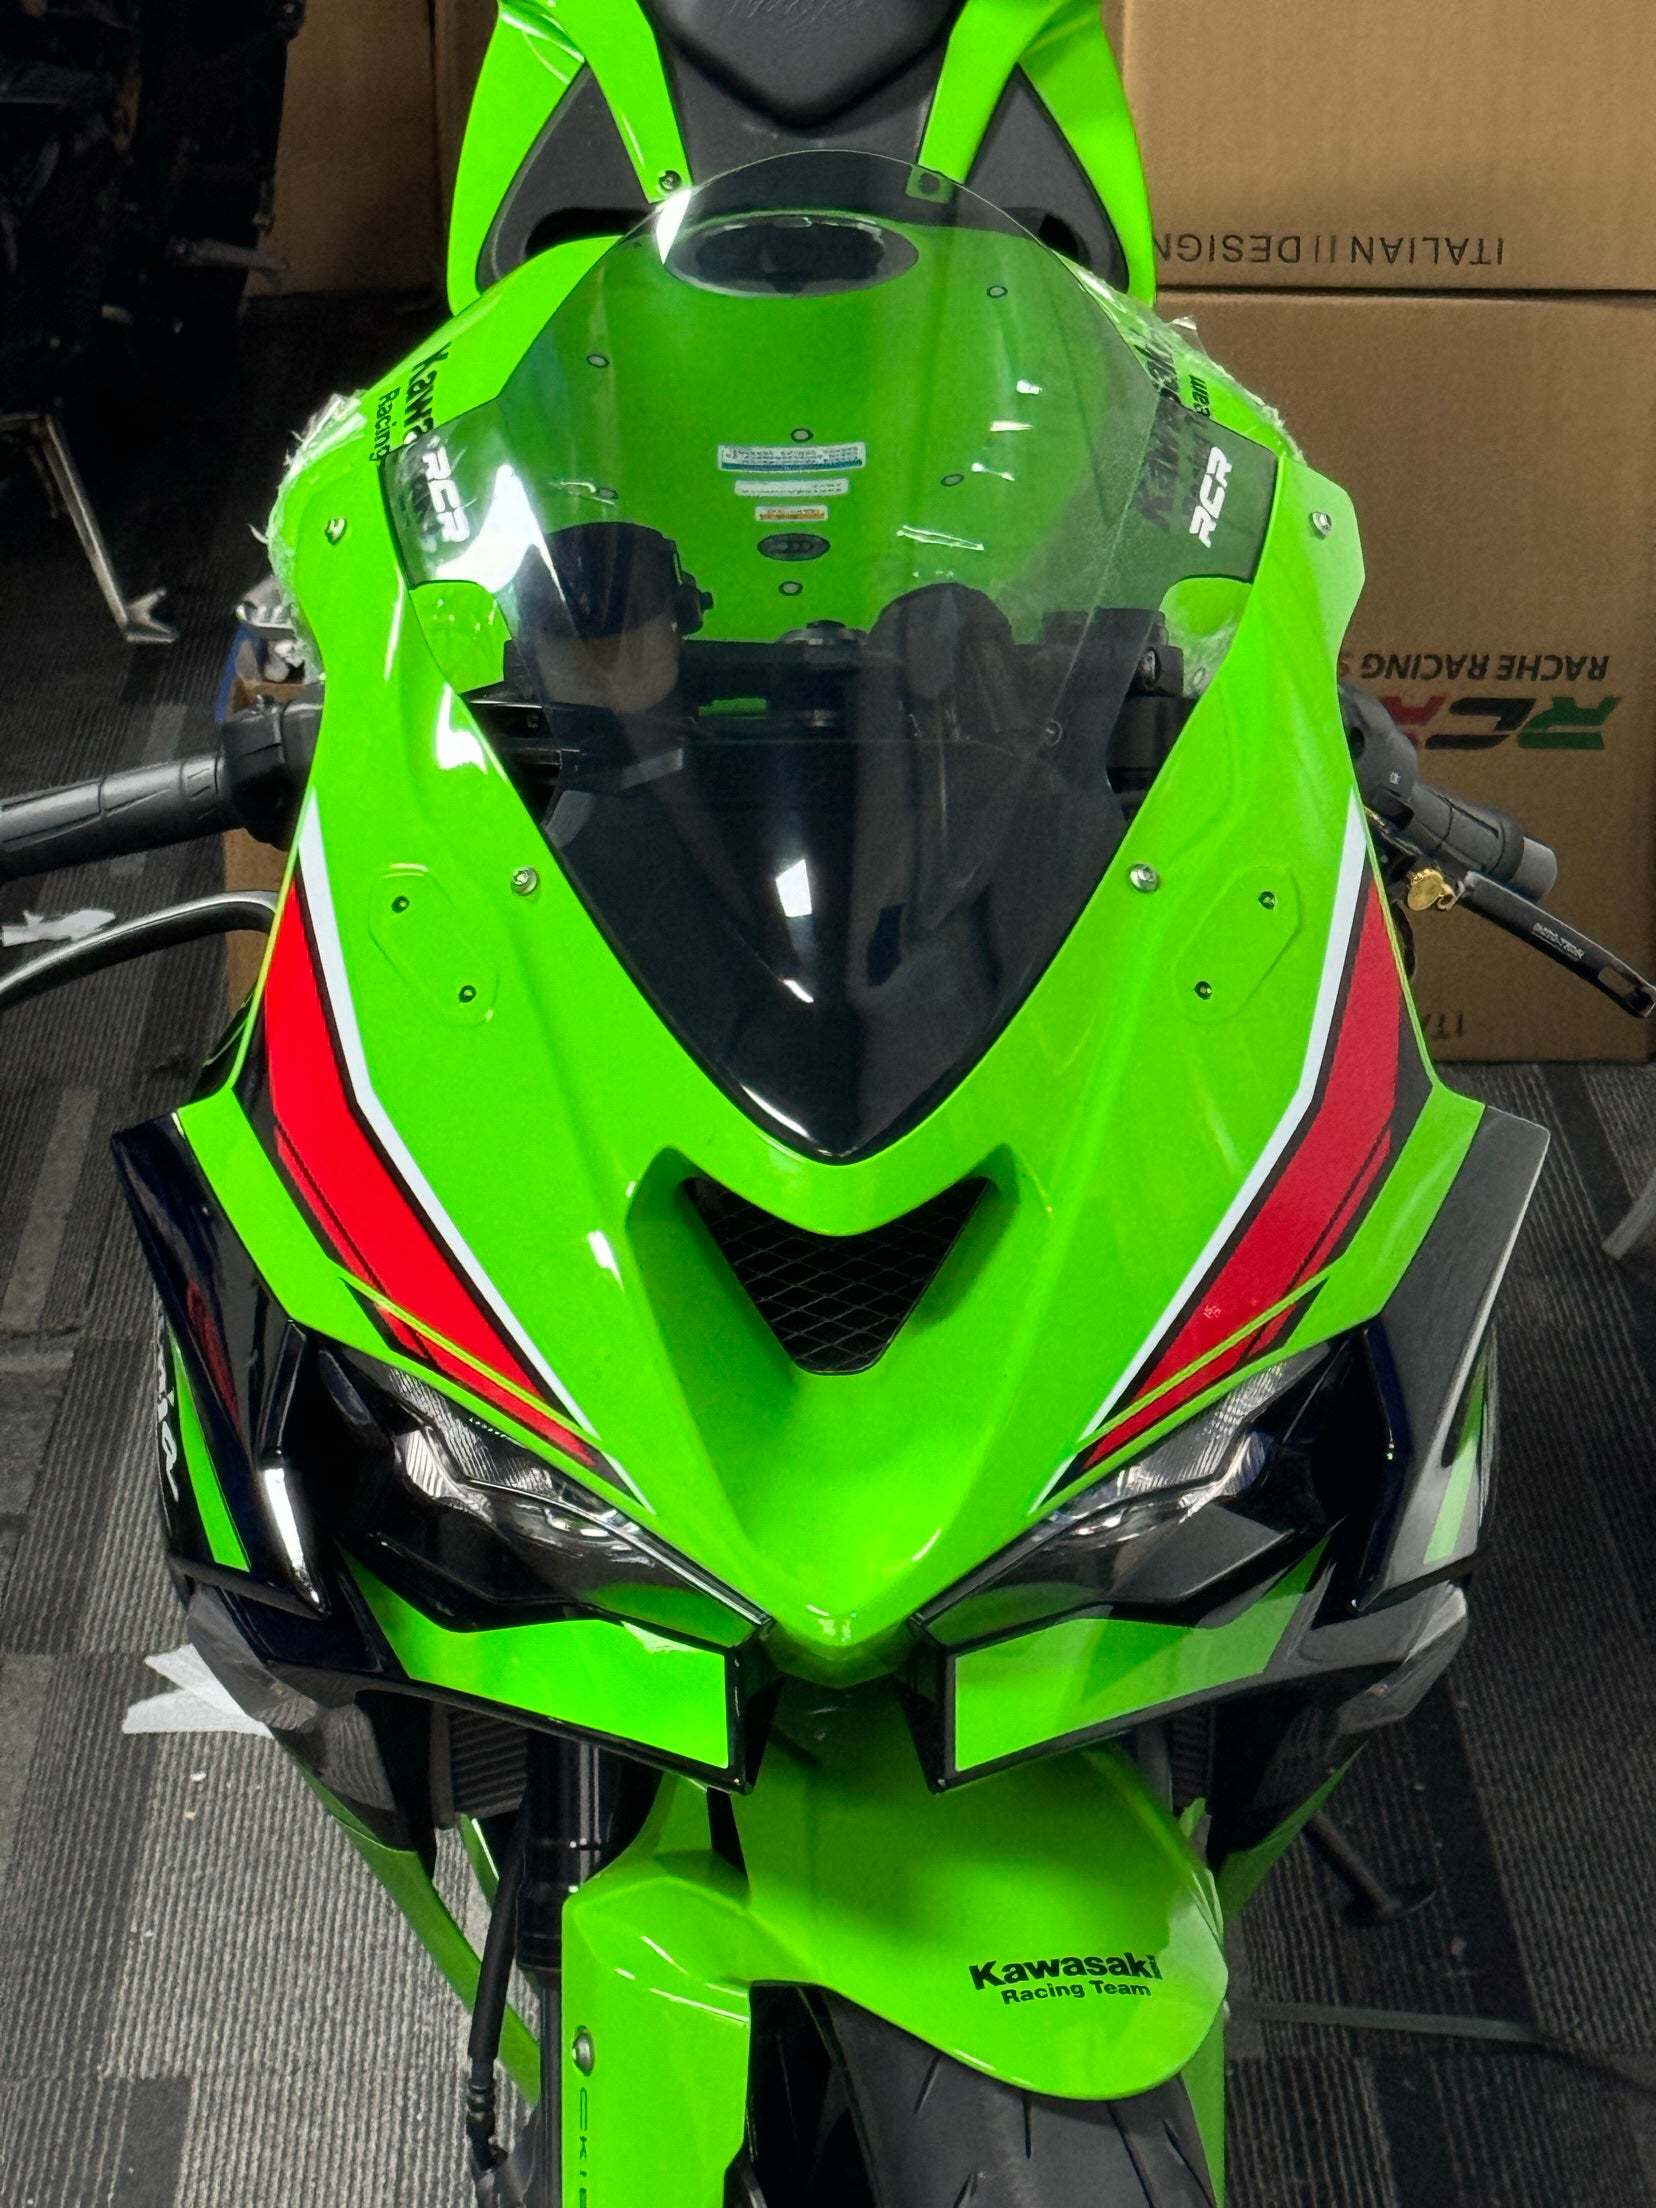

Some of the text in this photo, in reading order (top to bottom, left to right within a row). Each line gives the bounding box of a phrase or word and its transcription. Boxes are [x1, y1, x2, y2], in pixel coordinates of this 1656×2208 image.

[1154, 232, 1505, 266] ITALIAN DESIGN
[368, 385, 401, 463] Racing
[422, 445, 471, 543] RCR
[1188, 446, 1233, 549] RCR
[1359, 652, 1611, 682] RACHE RACING
[968, 1951, 1164, 1991] Kawasaki
[1000, 1979, 1152, 2006] Racing Team
